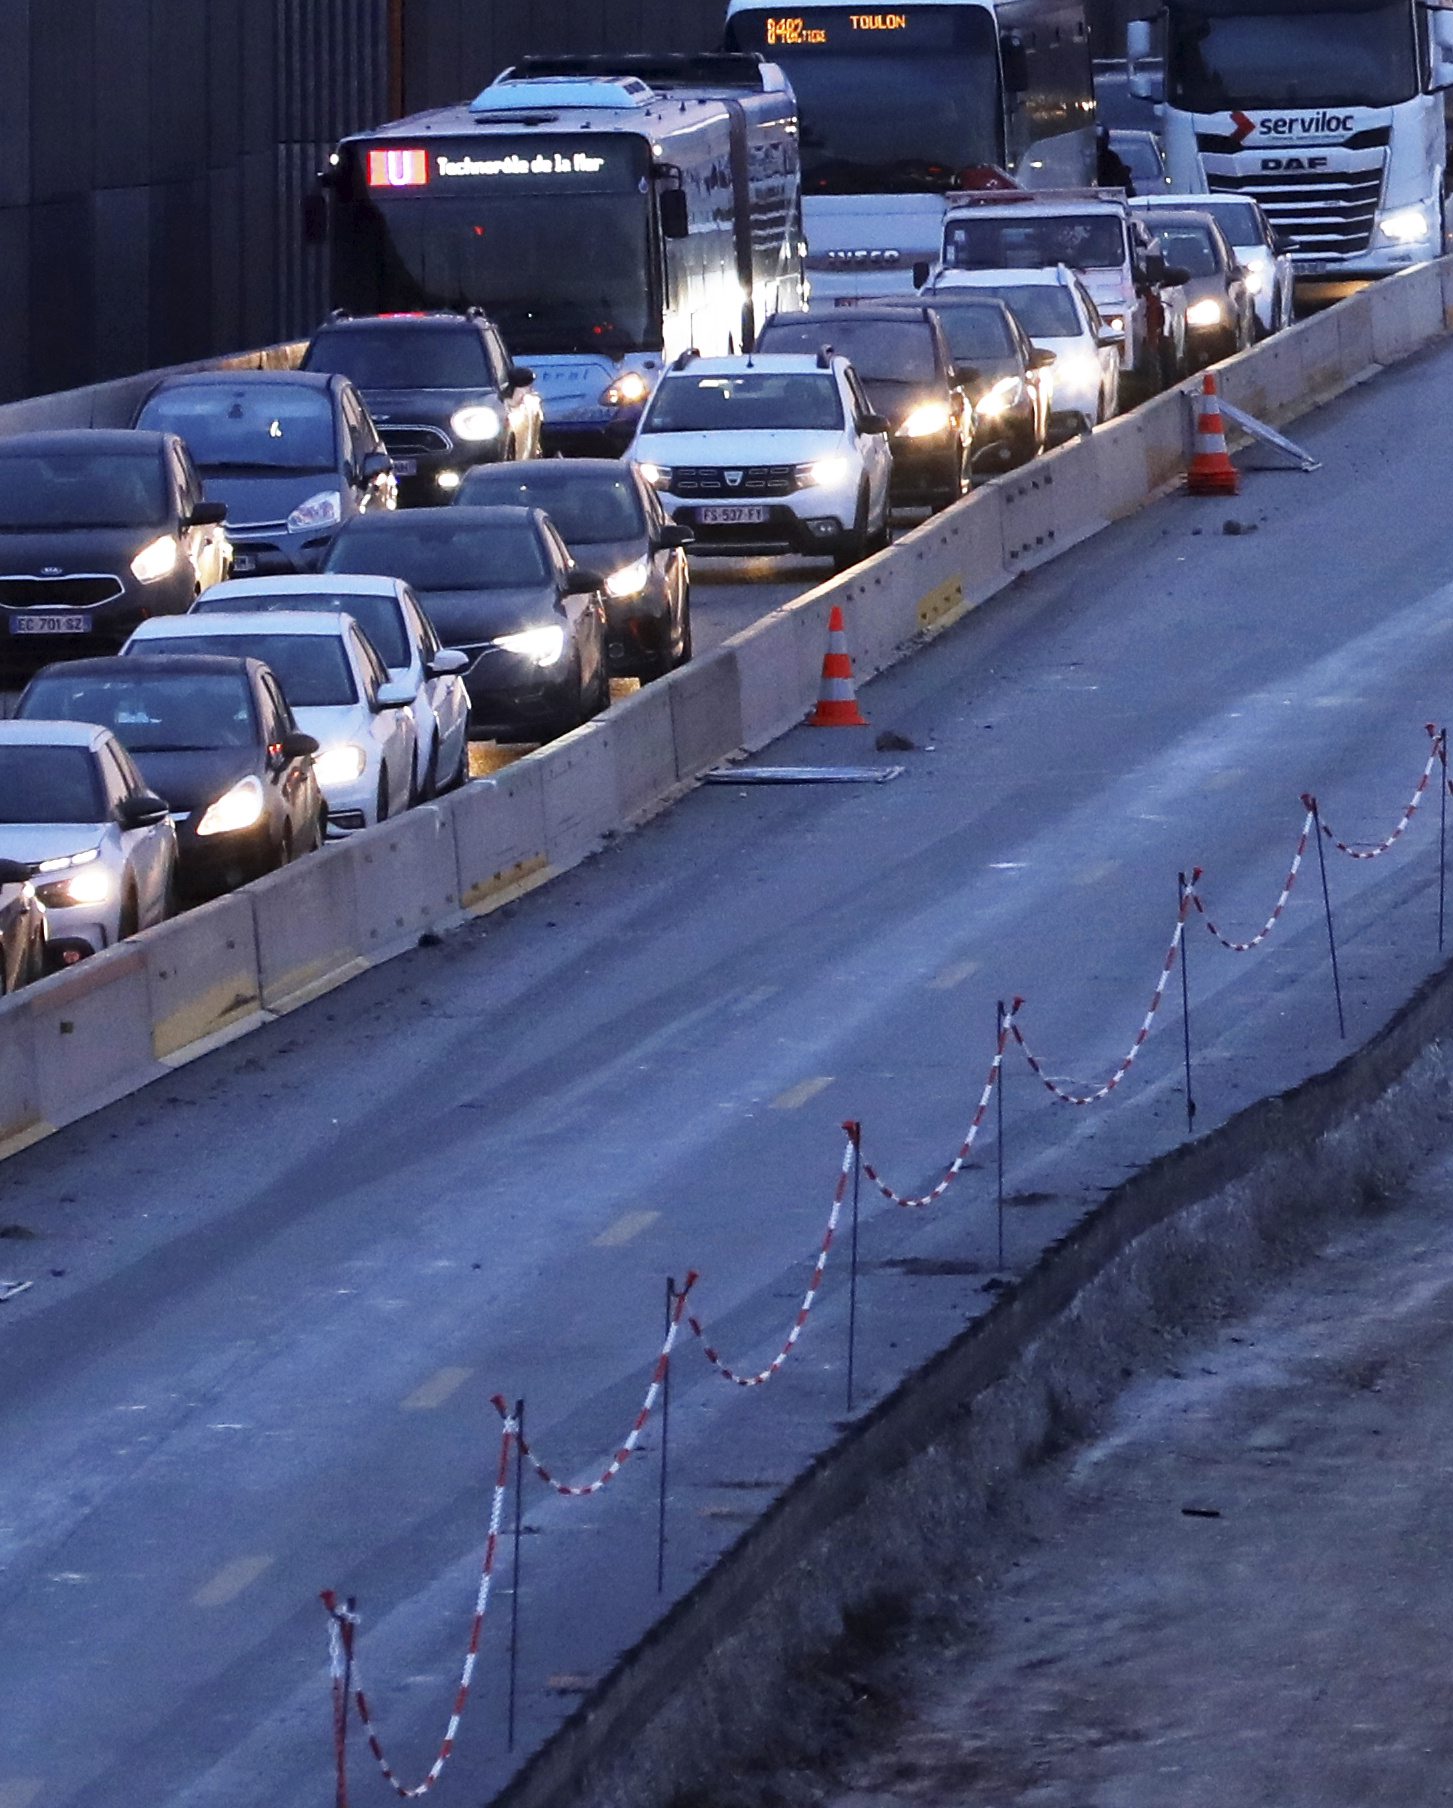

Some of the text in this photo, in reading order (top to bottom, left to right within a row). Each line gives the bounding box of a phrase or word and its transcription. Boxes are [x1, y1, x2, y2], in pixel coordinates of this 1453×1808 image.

[849, 14, 906, 30] TOULON
[1259, 111, 1354, 135] serviloc
[1261, 157, 1328, 171] DAF
